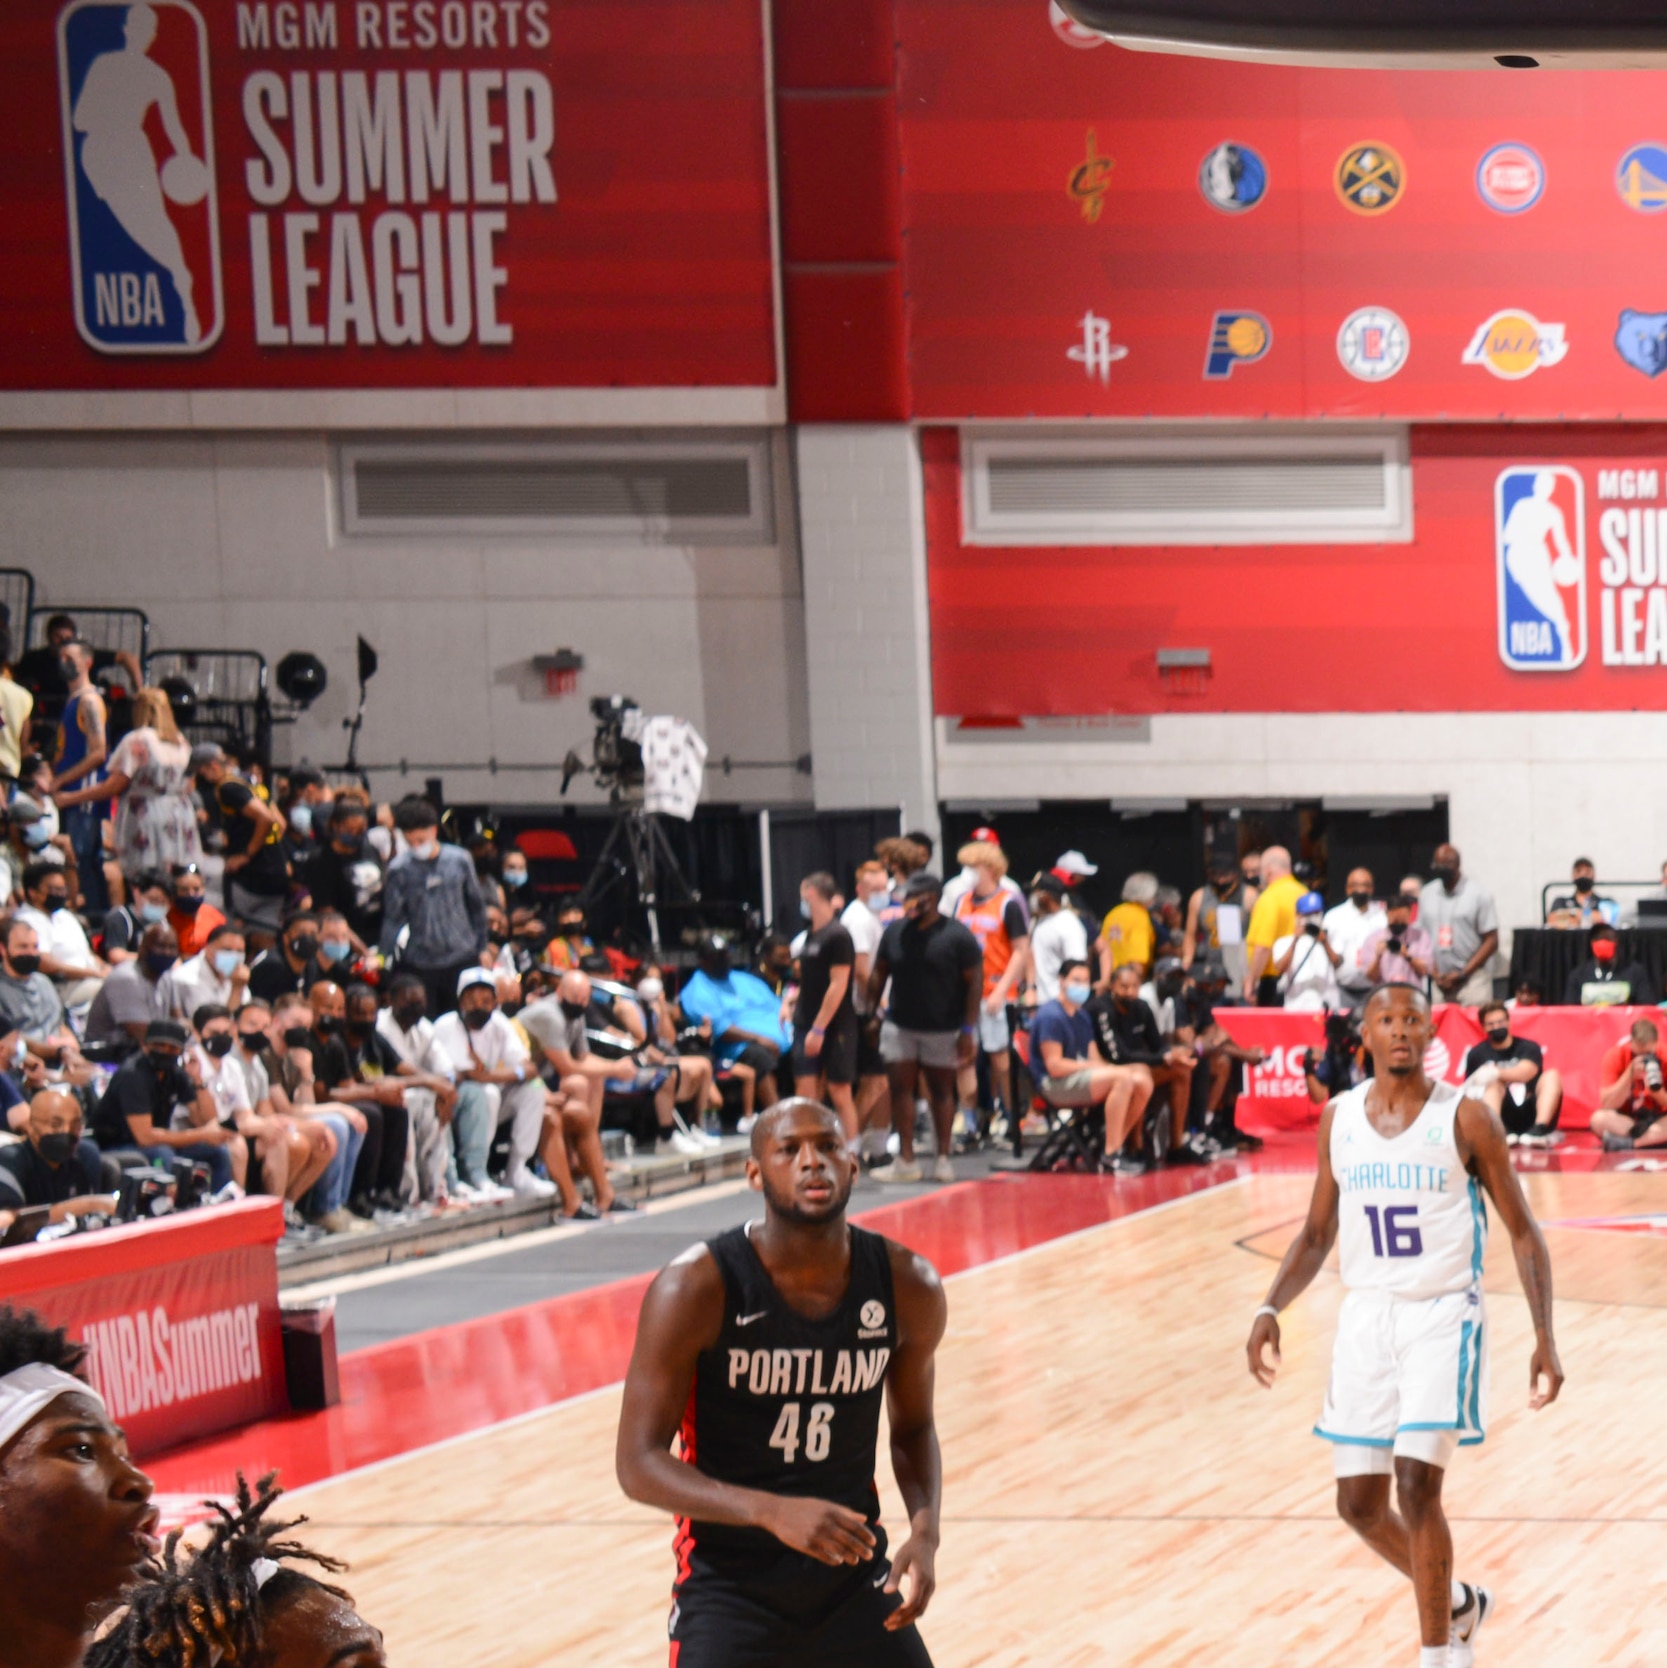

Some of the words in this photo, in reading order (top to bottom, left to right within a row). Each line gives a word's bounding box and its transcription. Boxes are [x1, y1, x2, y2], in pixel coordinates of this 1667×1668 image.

[238, 2, 337, 49] MGM
[357, 1, 551, 50] RESORTS
[243, 68, 557, 205] SUMMER
[94, 273, 165, 328] NBA
[250, 211, 513, 346] LEAGUE
[1598, 470, 1657, 499] MGM
[1510, 622, 1553, 656] NBA
[1340, 1162, 1448, 1193] CHARLOTTE
[1364, 1205, 1423, 1258] 16
[728, 1348, 890, 1395] PORTLAND
[769, 1402, 834, 1463] 46
